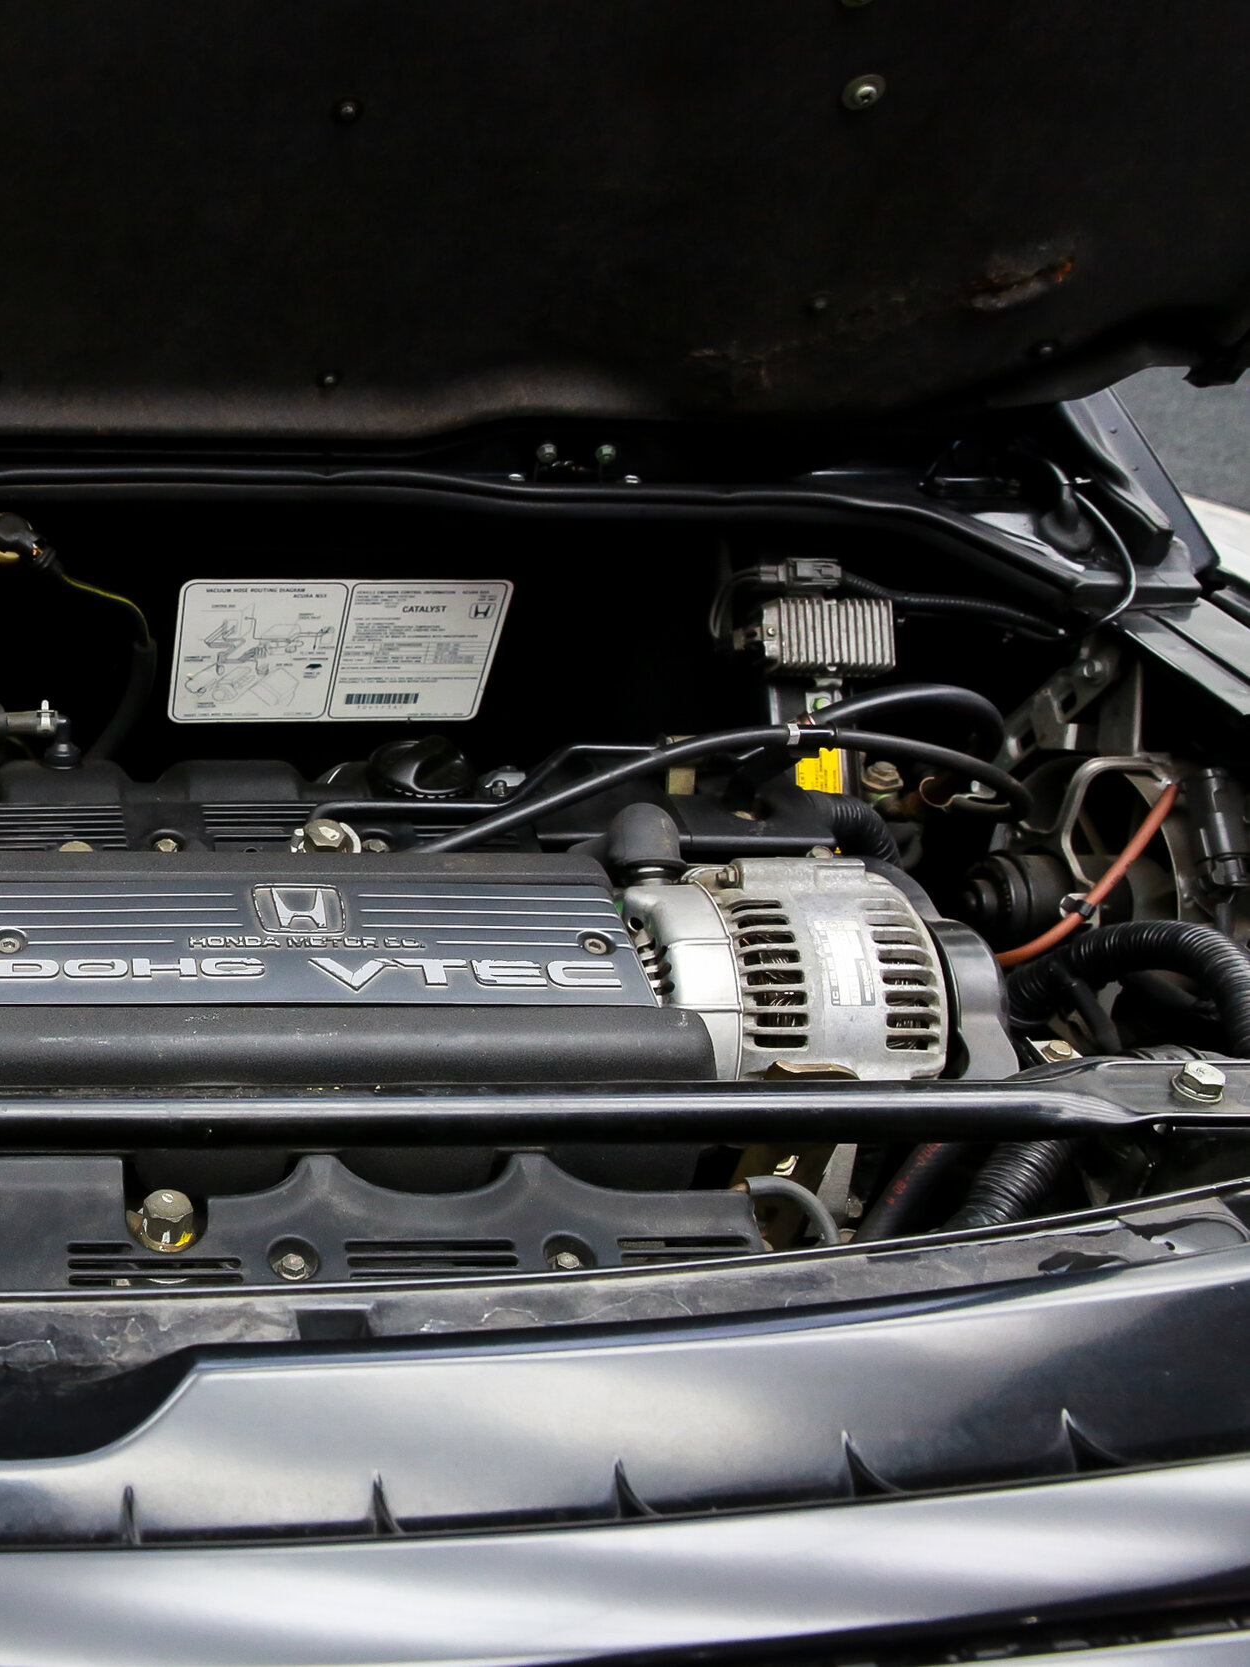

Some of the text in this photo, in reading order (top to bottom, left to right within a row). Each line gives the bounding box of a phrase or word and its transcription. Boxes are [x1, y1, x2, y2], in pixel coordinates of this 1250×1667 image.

[402, 605, 447, 613] CATALYST
[189, 935, 425, 949] HONDA MOTOR CO.
[308, 956, 623, 992] VTEC
